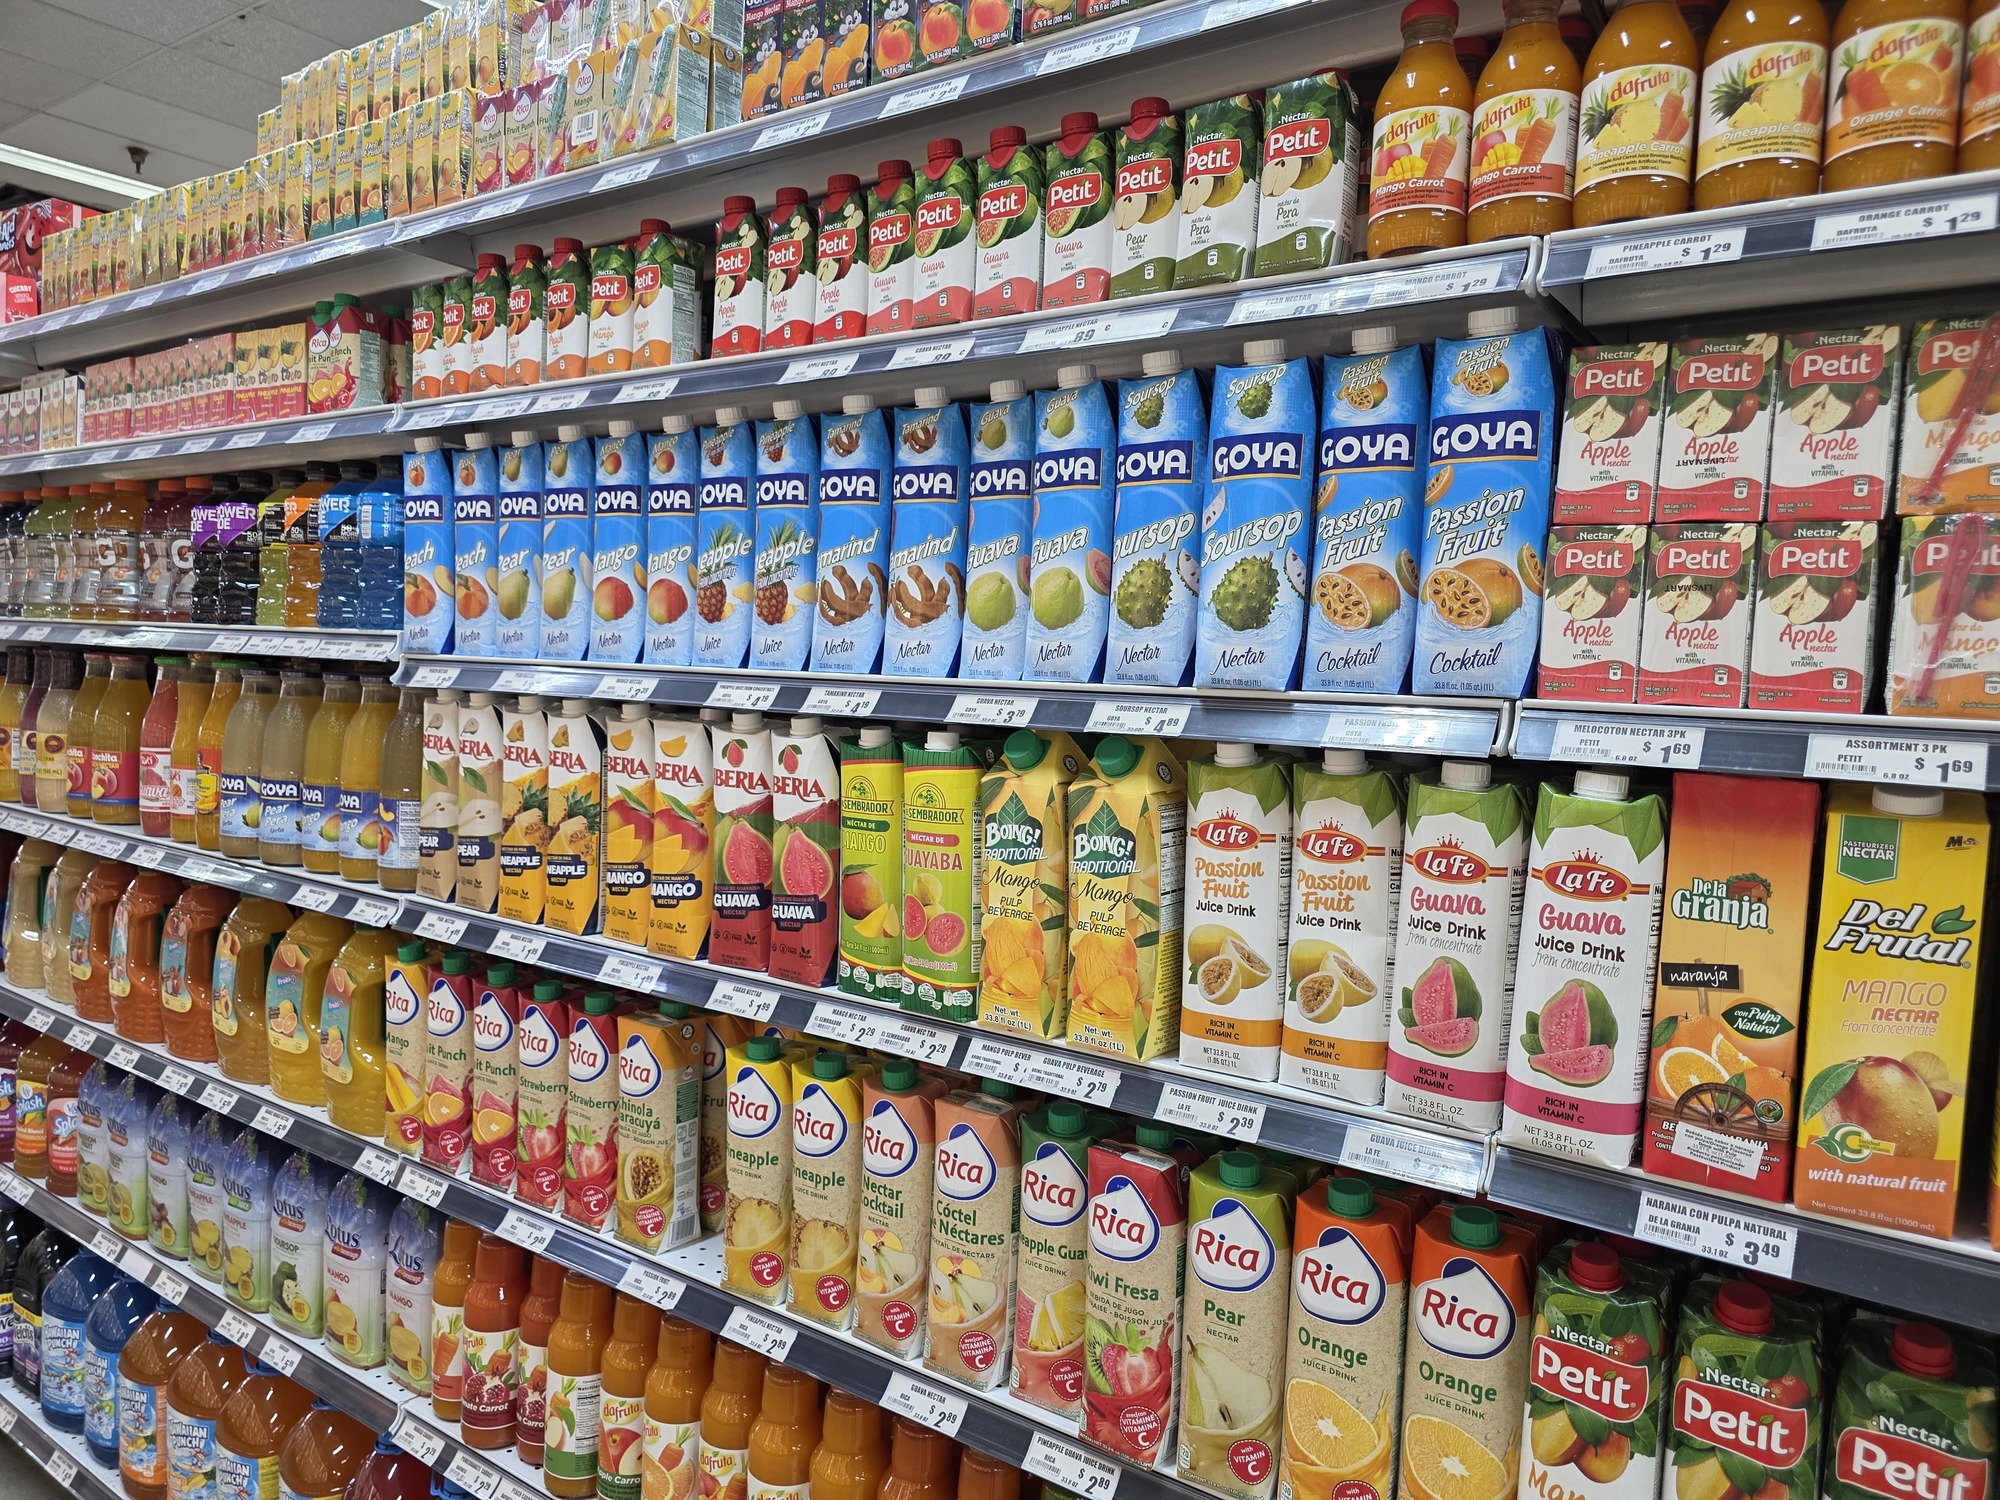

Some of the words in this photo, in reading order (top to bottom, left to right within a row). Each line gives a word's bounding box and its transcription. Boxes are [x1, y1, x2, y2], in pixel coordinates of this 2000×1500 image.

[1750, 49, 1811, 80] dafruta
[1610, 70, 1670, 106] dafruta
[1386, 112, 1436, 144] dafruta
[1187, 148, 1230, 174] Petit
[1588, 142, 1646, 163] Pineapple
[1650, 142, 1684, 154] Carrot
[1119, 167, 1163, 193] Petit
[1375, 179, 1406, 197] Mango
[1408, 178, 1444, 188] Carrot
[918, 203, 954, 225] Petit
[1859, 211, 1902, 223] ORANGE
[1904, 204, 1949, 216] CARROT
[1055, 241, 1083, 254] Guava
[1125, 233, 1147, 246] Pear
[1623, 240, 1672, 252] PINEAPPLE
[1673, 235, 1712, 246] CARROT
[1609, 255, 1644, 265] DAFRUTA
[1405, 275, 1433, 285] MANGO
[1435, 272, 1467, 281] CARROT
[1227, 364, 1287, 398] Soursop
[1046, 392, 1077, 412] Guava
[902, 412, 940, 436] Tamarind
[1432, 421, 1532, 456] GOYA
[1426, 487, 1525, 542] Passion
[1201, 510, 1302, 567] Soursop
[1436, 518, 1509, 565] Fruit
[1798, 528, 1838, 539] Nectar
[1781, 546, 1851, 570] Petit
[759, 639, 782, 654] Juice
[1779, 623, 1838, 653] Apple
[1033, 643, 1072, 666] Nectar
[1115, 647, 1161, 671] Nectar
[1210, 650, 1266, 675] Nectar
[1429, 642, 1502, 675] Cocktail
[1115, 705, 1141, 714] SOURSOP
[1142, 706, 1167, 715] NECTAR
[1574, 725, 1626, 735] MELOCOTON
[1628, 727, 1664, 738] NECTAR
[1667, 729, 1687, 739] 3PK
[1846, 740, 1918, 753] ASSORTMENT
[1922, 743, 1929, 753] 3
[1932, 743, 1947, 754] PK
[1838, 754, 1863, 763] PETIT
[261, 783, 298, 797] GOYA
[265, 803, 289, 816] Pear
[908, 808, 958, 823] SEMBRADOR
[847, 819, 869, 828] NÉCTAR
[458, 844, 479, 857] PEAR
[1074, 833, 1134, 859] BOING!
[1843, 840, 1895, 851] PASTEURIZED
[1843, 846, 1895, 861] NECTAR
[1070, 861, 1141, 874] TRADITIONAL
[1297, 869, 1370, 891] Passion
[714, 893, 760, 908] GUAVA
[1070, 880, 1136, 912] Mango
[1303, 892, 1355, 913] Fruit
[723, 910, 747, 918] NECTAR
[1090, 911, 1114, 923] PULP
[1539, 903, 1626, 935] Guava
[1671, 889, 1768, 930] Granja
[1841, 899, 1926, 930] Del
[1077, 922, 1126, 938] BEVERAGE
[1296, 913, 1325, 927] Juice
[1330, 917, 1362, 932] Drink
[1534, 934, 1574, 953] Juice
[1582, 943, 1626, 963] Drink
[1824, 924, 1973, 966] Frutal
[1530, 951, 1558, 971] from
[1560, 957, 1621, 979] concentrate
[1670, 966, 1729, 987] naranja
[1842, 979, 1948, 1005] MANGO
[1734, 1008, 1749, 1020] con
[1749, 1006, 1781, 1026] Pulpa
[1871, 1007, 1939, 1023] NECTAR
[1085, 1025, 1100, 1035] Net.
[1101, 1029, 1113, 1038] wt.
[1735, 1017, 1779, 1035] Natural
[1840, 1020, 1869, 1033] From
[1871, 1022, 1936, 1037] concentrate
[1074, 1033, 1092, 1043] 33.8
[619, 1055, 651, 1083] Rica
[1042, 1057, 1061, 1069] GUAVA
[1063, 1061, 1076, 1072] PULP
[1076, 1063, 1105, 1078] BEVERAGE
[520, 1076, 569, 1095] Strawberry
[1169, 1088, 1196, 1100] PASSION
[1197, 1093, 1216, 1105] FRUIT
[1218, 1098, 1235, 1109] JUICE
[1236, 1104, 1258, 1115] DIRNK
[1177, 1103, 1184, 1111] LA
[1185, 1104, 1191, 1112] FE
[1545, 1096, 1565, 1110] RICH
[1568, 1101, 1579, 1112] IN
[1538, 1105, 1573, 1121] VITAMIN
[1575, 1112, 1585, 1125] C
[1524, 1124, 1541, 1135] NET
[1543, 1127, 1564, 1141] 33.8
[1566, 1133, 1579, 1145] FL.
[1581, 1137, 1596, 1150] OZ.
[1808, 1167, 1843, 1183] with
[1847, 1172, 1906, 1188] natural
[1909, 1176, 1946, 1192] fruit
[936, 1200, 977, 1227] Cóctel
[1646, 1196, 1687, 1217] NARANJA
[1689, 1208, 1709, 1222] CON
[1711, 1213, 1741, 1230] PULPA
[1743, 1222, 1787, 1241] NATURAL
[1812, 1200, 1826, 1208] Net
[1827, 1202, 1856, 1214] content
[1858, 1210, 1876, 1219] 33.8
[939, 1219, 1005, 1247] Néctares
[1092, 1203, 1145, 1244] Rica
[1648, 1214, 1658, 1224] DE
[1659, 1218, 1669, 1227] LA
[1670, 1220, 1700, 1234] GRANJA
[328, 1268, 349, 1284] MANGO
[1300, 1256, 1370, 1306] Rica
[1115, 1277, 1159, 1301] Fresa
[1204, 1299, 1245, 1328] Pear
[1206, 1327, 1239, 1344] NECTAR
[1555, 1325, 1613, 1355] Nectar
[1298, 1327, 1368, 1369] Orange
[1302, 1357, 1327, 1375] JUICE
[1329, 1366, 1357, 1384] DRINK
[1536, 1343, 1631, 1411] Petit
[910, 1383, 927, 1396] GUAVA
[928, 1390, 947, 1404] NECTAR
[603, 1403, 641, 1418] dafruta
[1037, 1436, 1062, 1453] PINEAPPLE
[1063, 1447, 1081, 1461] GUAVA
[1082, 1455, 1096, 1467] JUICE
[1097, 1463, 1116, 1476] DRINK
